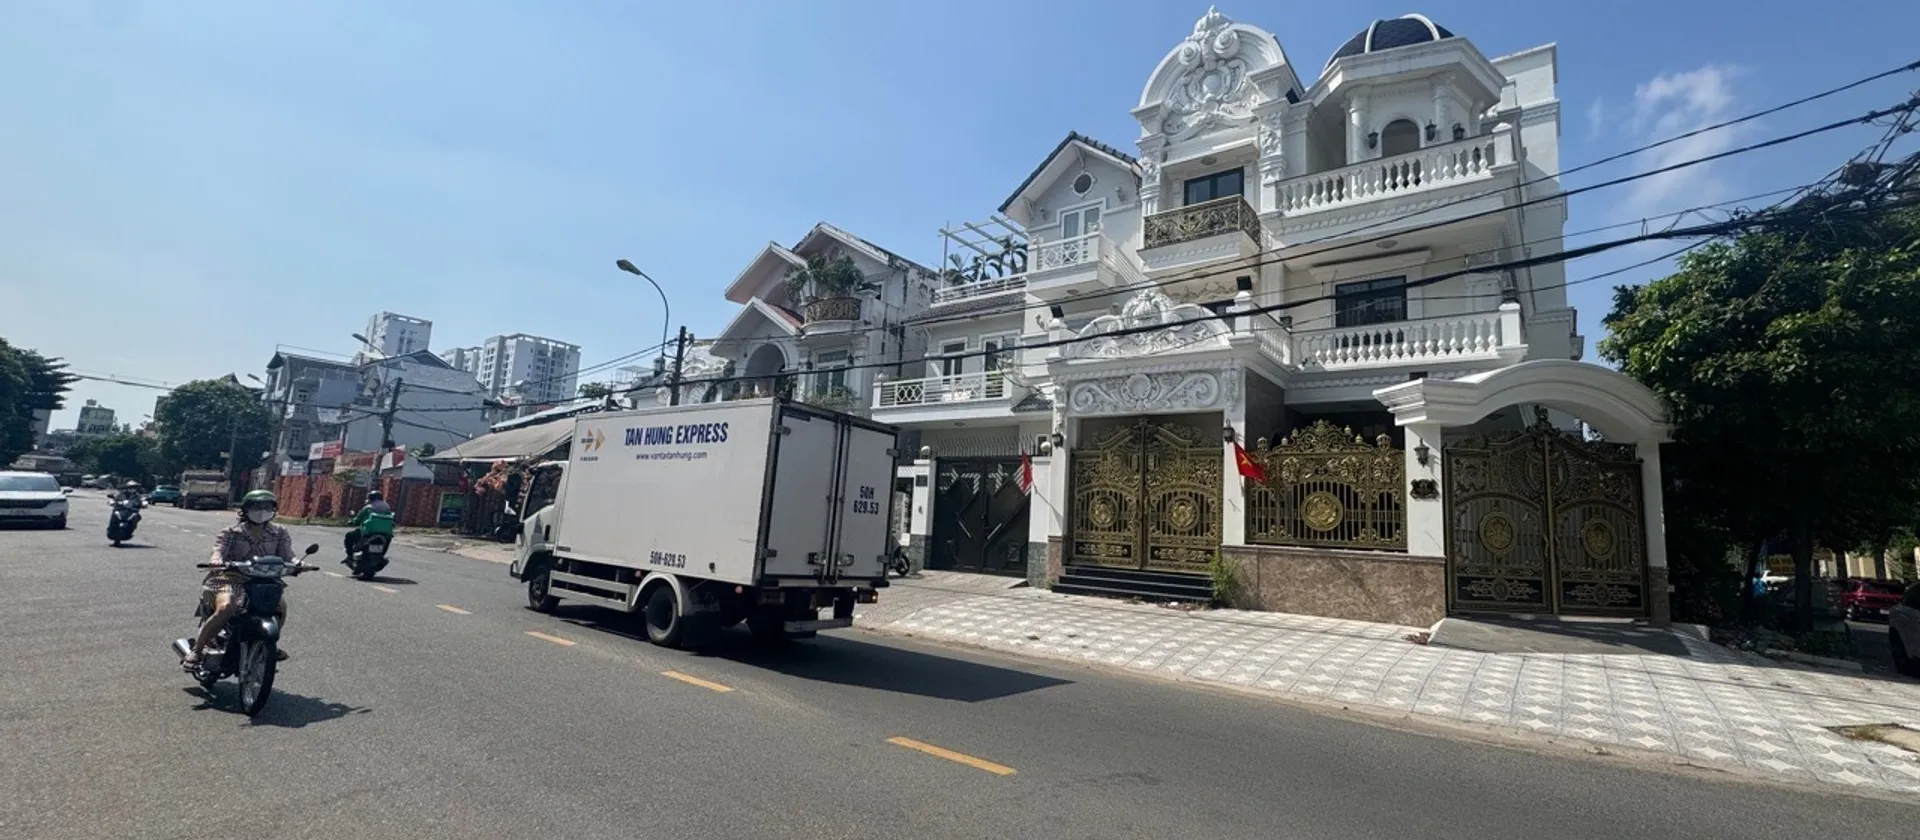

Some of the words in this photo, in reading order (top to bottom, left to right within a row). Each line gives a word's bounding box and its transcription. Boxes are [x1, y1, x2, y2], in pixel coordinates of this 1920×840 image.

[625, 428, 643, 446] TAN
[644, 425, 673, 445] HUNG
[675, 422, 729, 444] EXPRESS
[860, 485, 875, 499] 50H
[853, 499, 879, 515] 629.53
